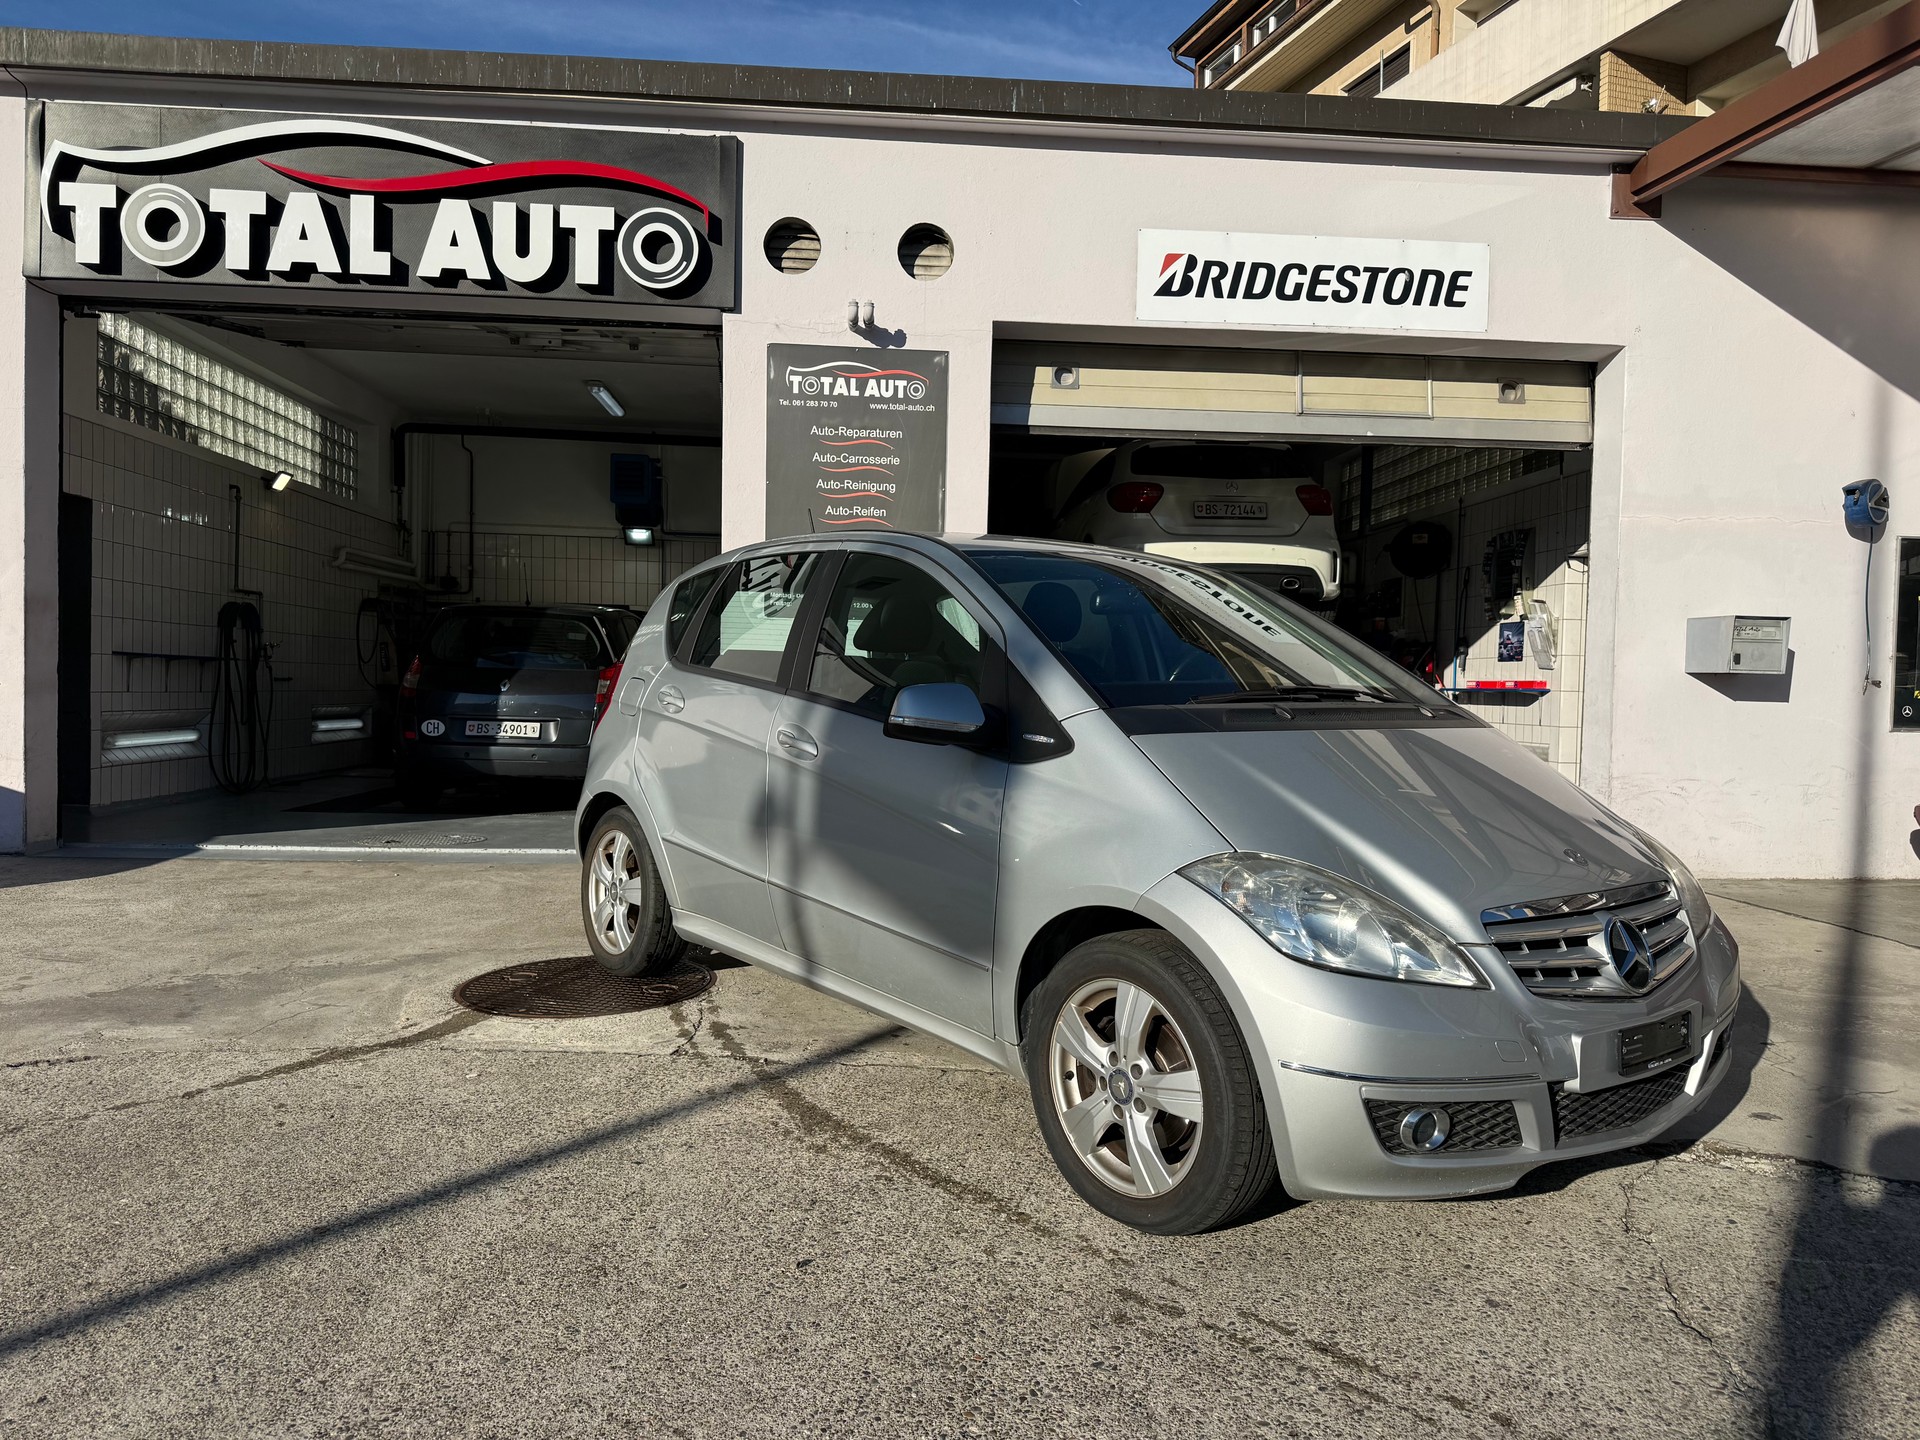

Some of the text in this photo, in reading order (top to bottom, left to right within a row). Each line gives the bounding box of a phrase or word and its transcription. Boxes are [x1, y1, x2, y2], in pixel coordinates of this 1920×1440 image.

[59, 181, 699, 289] TOTAL AUTO
[1153, 253, 1473, 308] BRIDGESTONE
[789, 375, 926, 400] TOTAL AUTO
[792, 399, 805, 407] 061
[806, 399, 819, 408] 283
[819, 400, 829, 408] 70
[829, 400, 838, 408] 70
[869, 403, 935, 412] www.total-auto.ch
[810, 425, 903, 439] Auto-Reparaturen
[812, 452, 900, 465] Auto-Carrosserie
[816, 478, 896, 493] Auto-Reinigung
[825, 505, 887, 517] Auto-Reifen
[426, 721, 440, 734] CH
